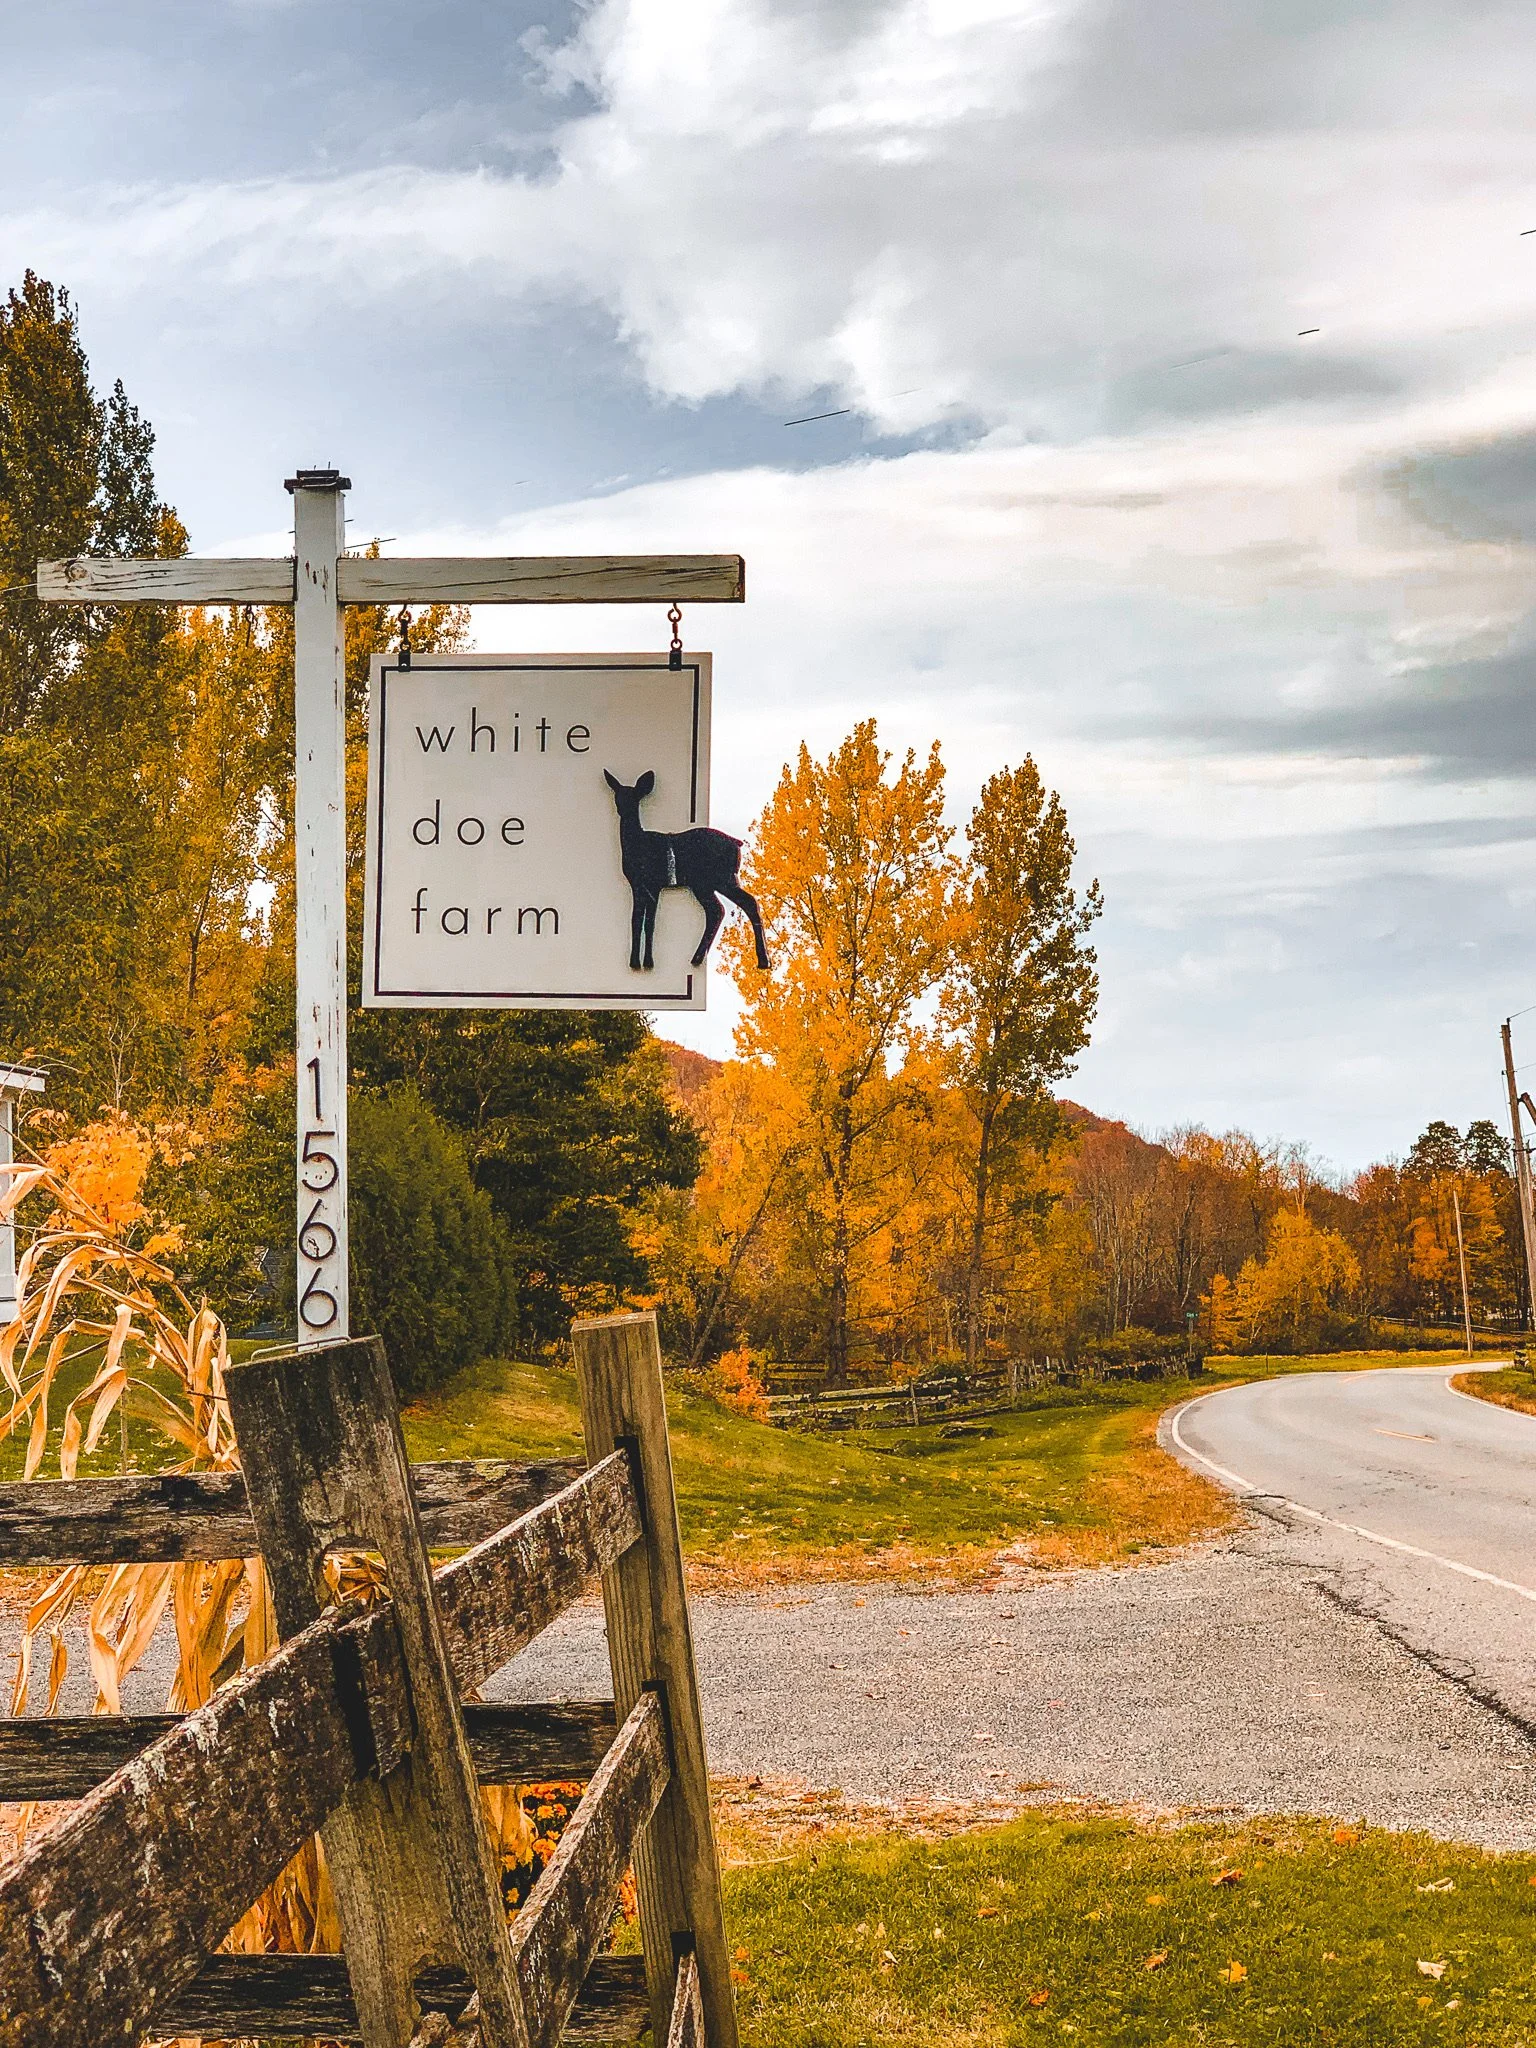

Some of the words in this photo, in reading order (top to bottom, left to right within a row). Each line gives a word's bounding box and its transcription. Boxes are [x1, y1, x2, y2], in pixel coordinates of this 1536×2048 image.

[416, 707, 590, 752] white
[413, 799, 524, 845] doe
[411, 888, 558, 935] farm
[299, 1057, 339, 1328] 1566
